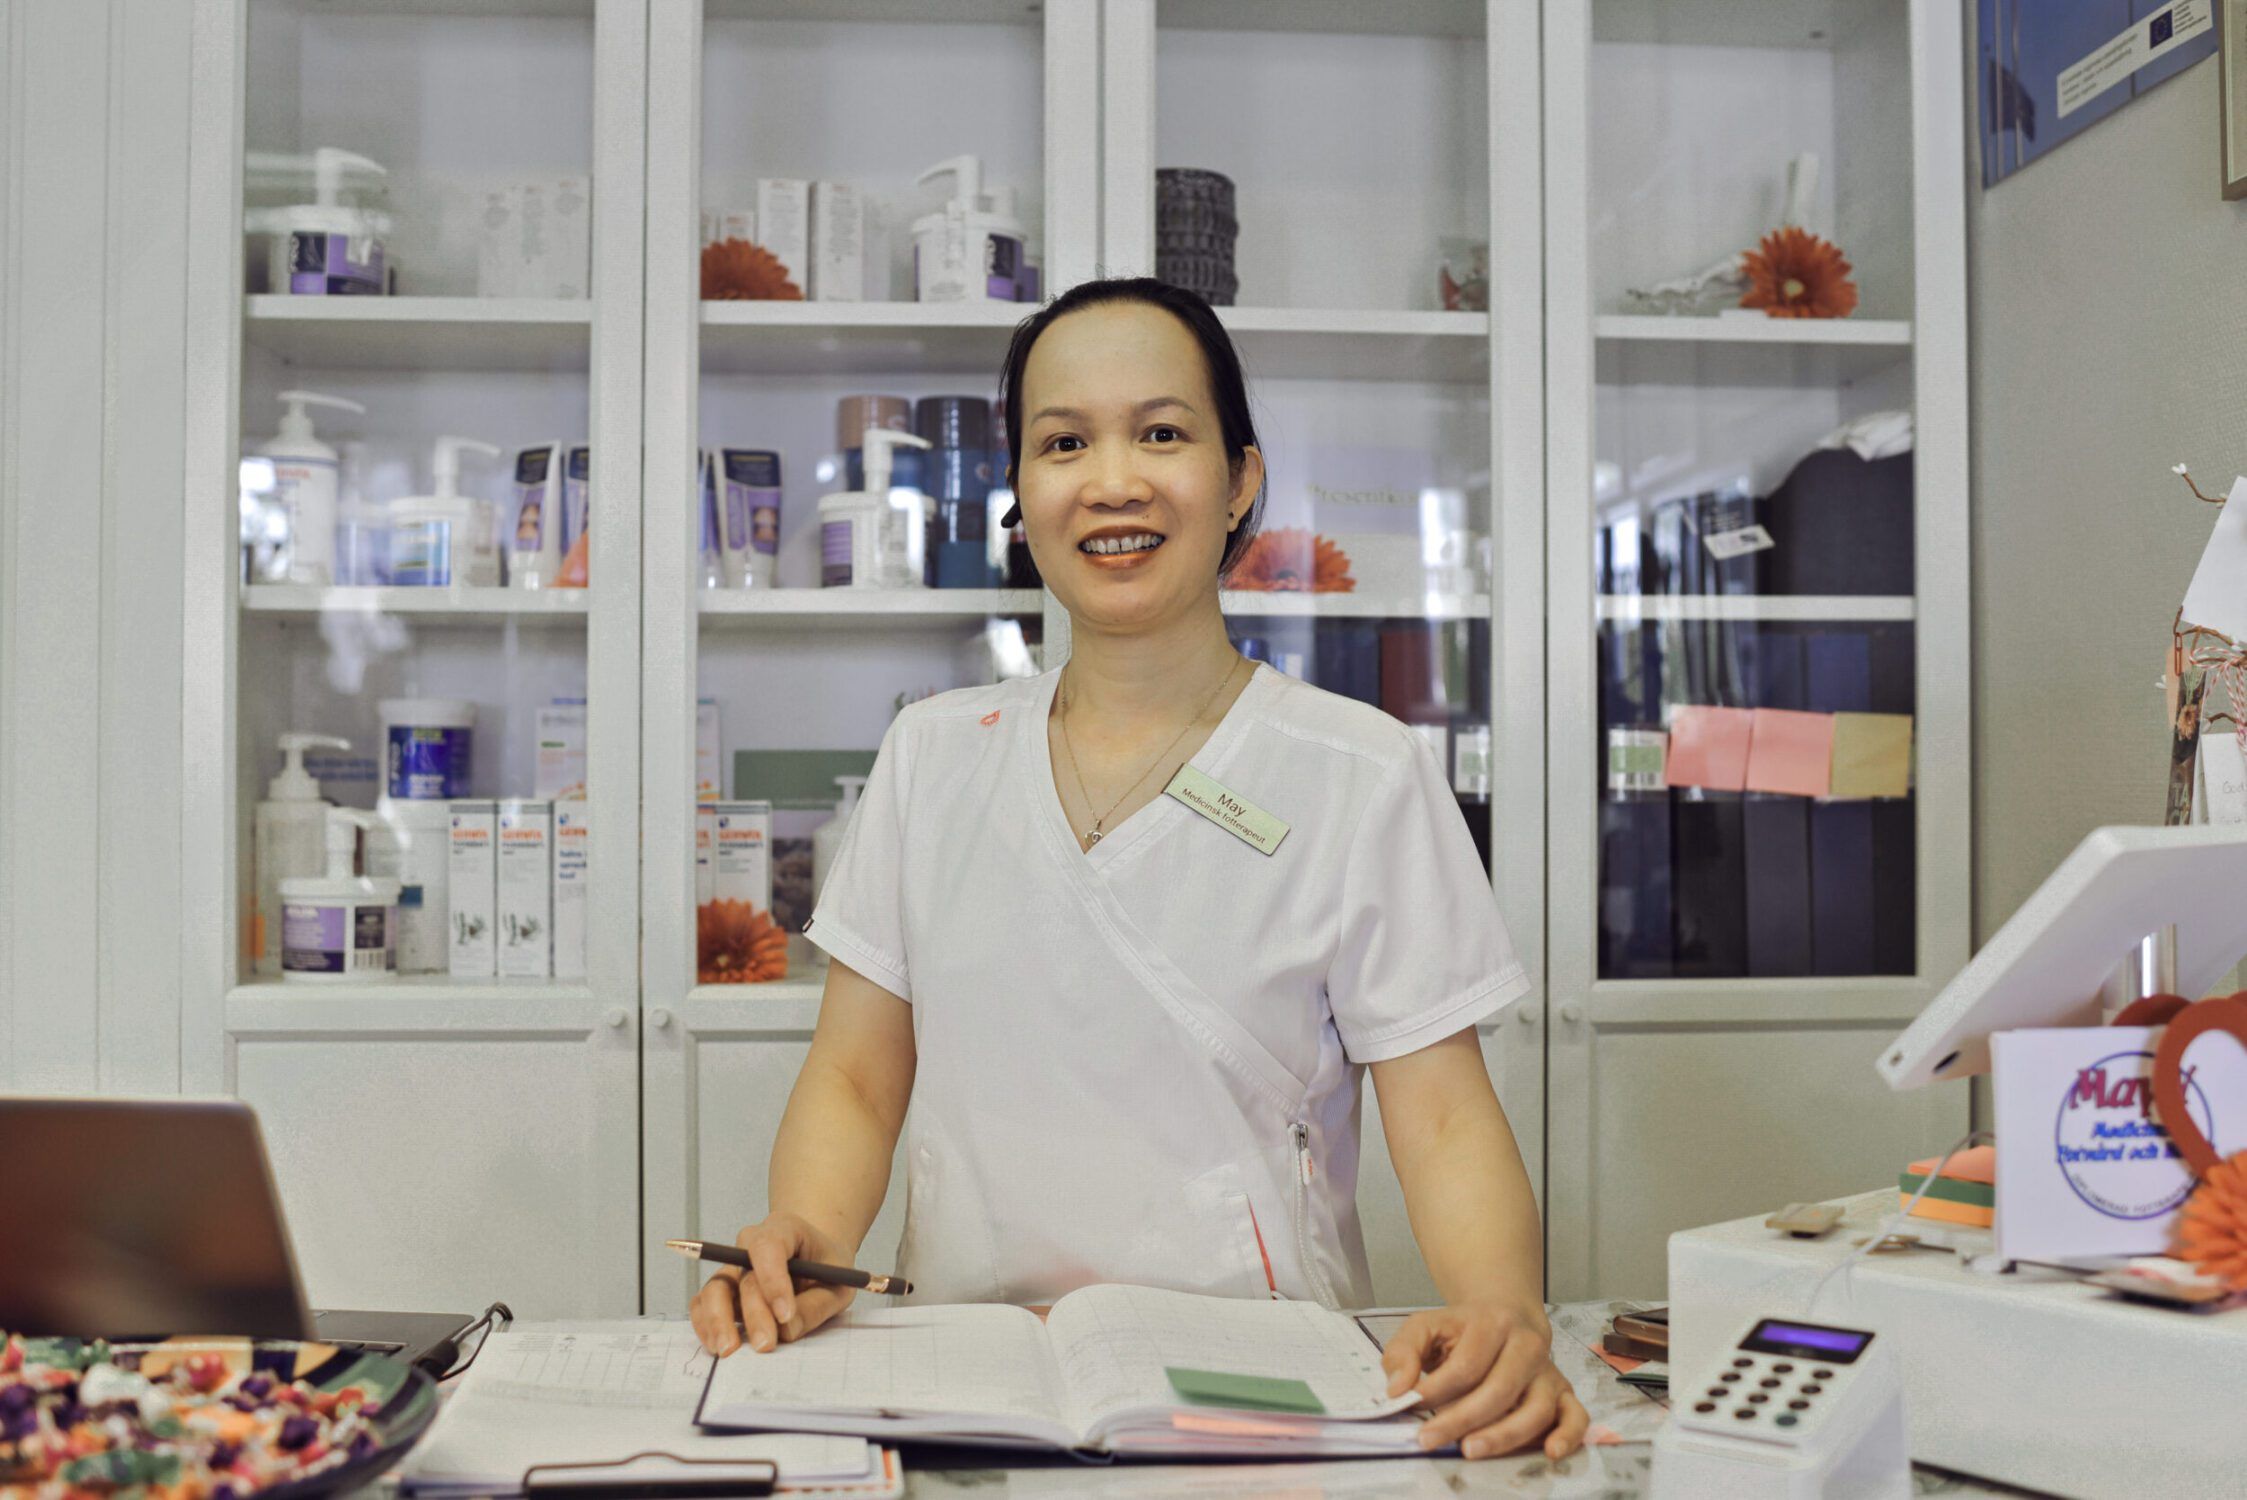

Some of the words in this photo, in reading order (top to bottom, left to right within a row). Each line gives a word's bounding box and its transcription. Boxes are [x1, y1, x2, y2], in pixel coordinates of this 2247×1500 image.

[1182, 788, 1221, 817] Medicinsk
[1221, 814, 1266, 844] fotterapeut
[1217, 793, 1247, 817] May
